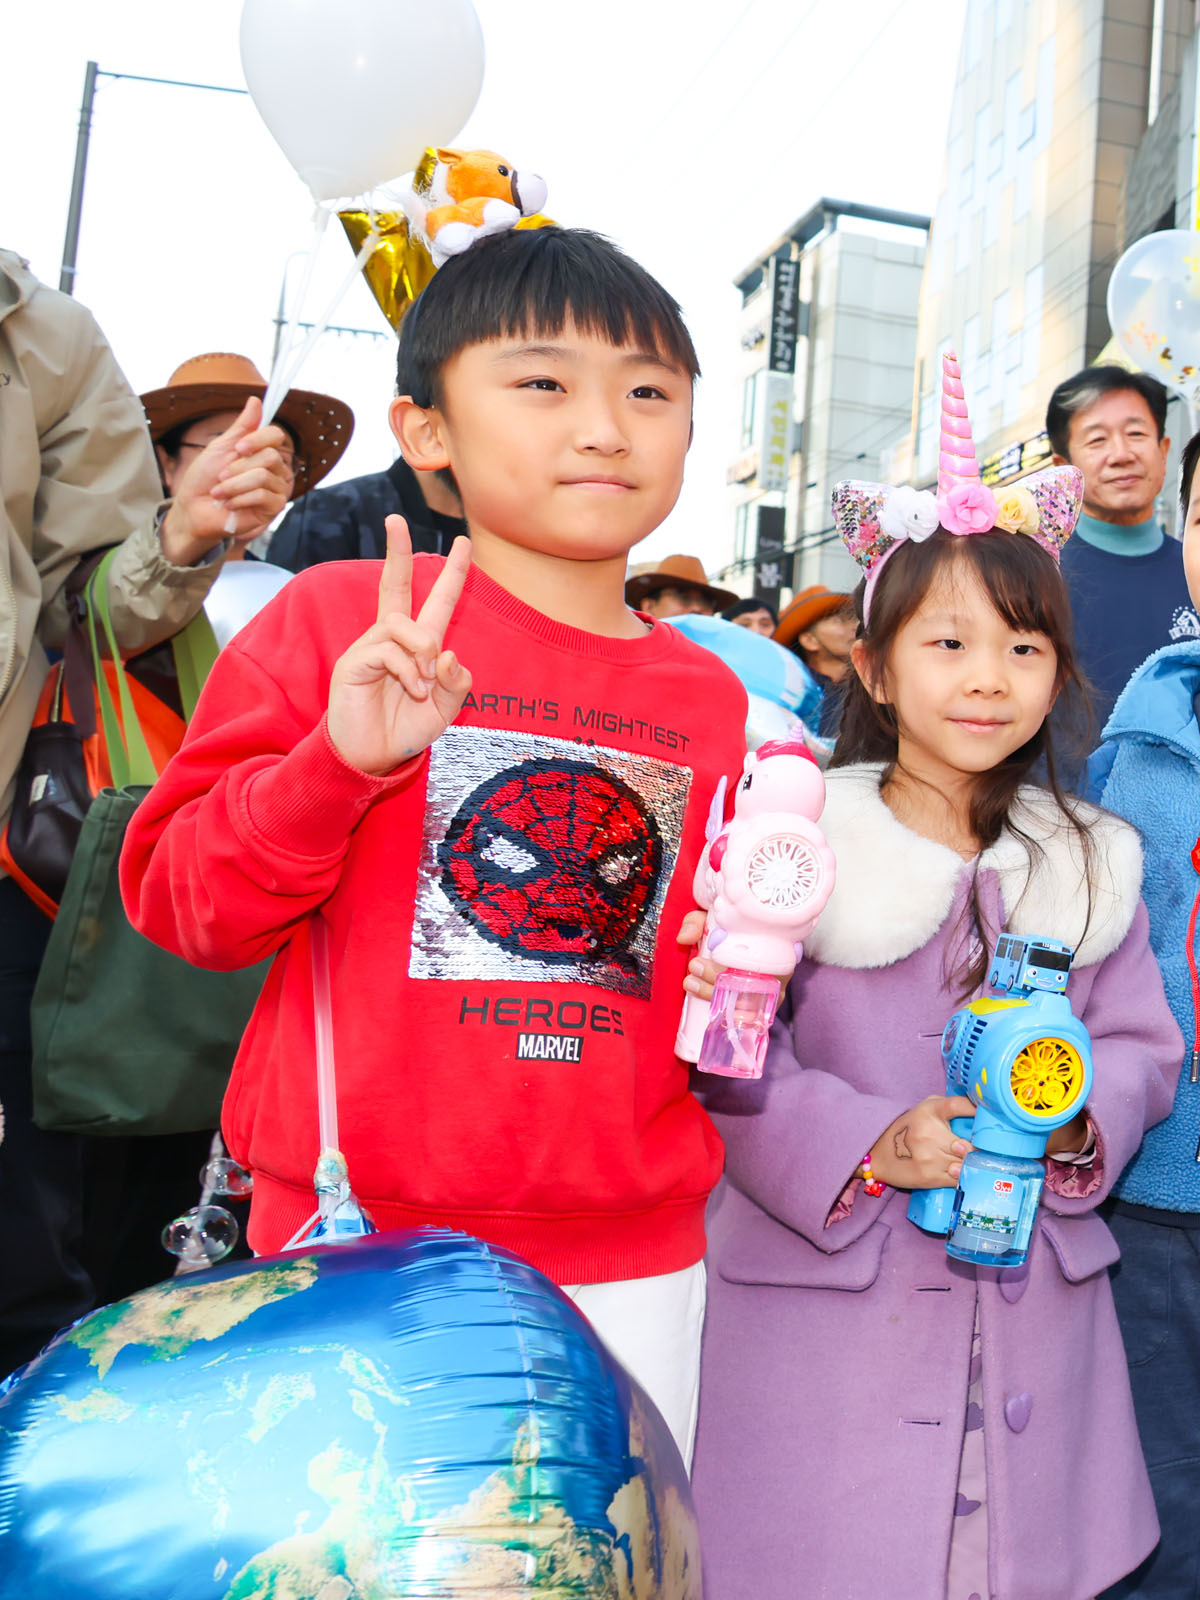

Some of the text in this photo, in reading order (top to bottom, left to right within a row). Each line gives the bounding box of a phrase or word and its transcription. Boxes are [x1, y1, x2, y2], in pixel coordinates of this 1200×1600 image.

[460, 691, 690, 753] ARTH'S MIGHTIEST
[459, 996, 625, 1036] HEROES
[517, 1034, 582, 1062] MARVEL
